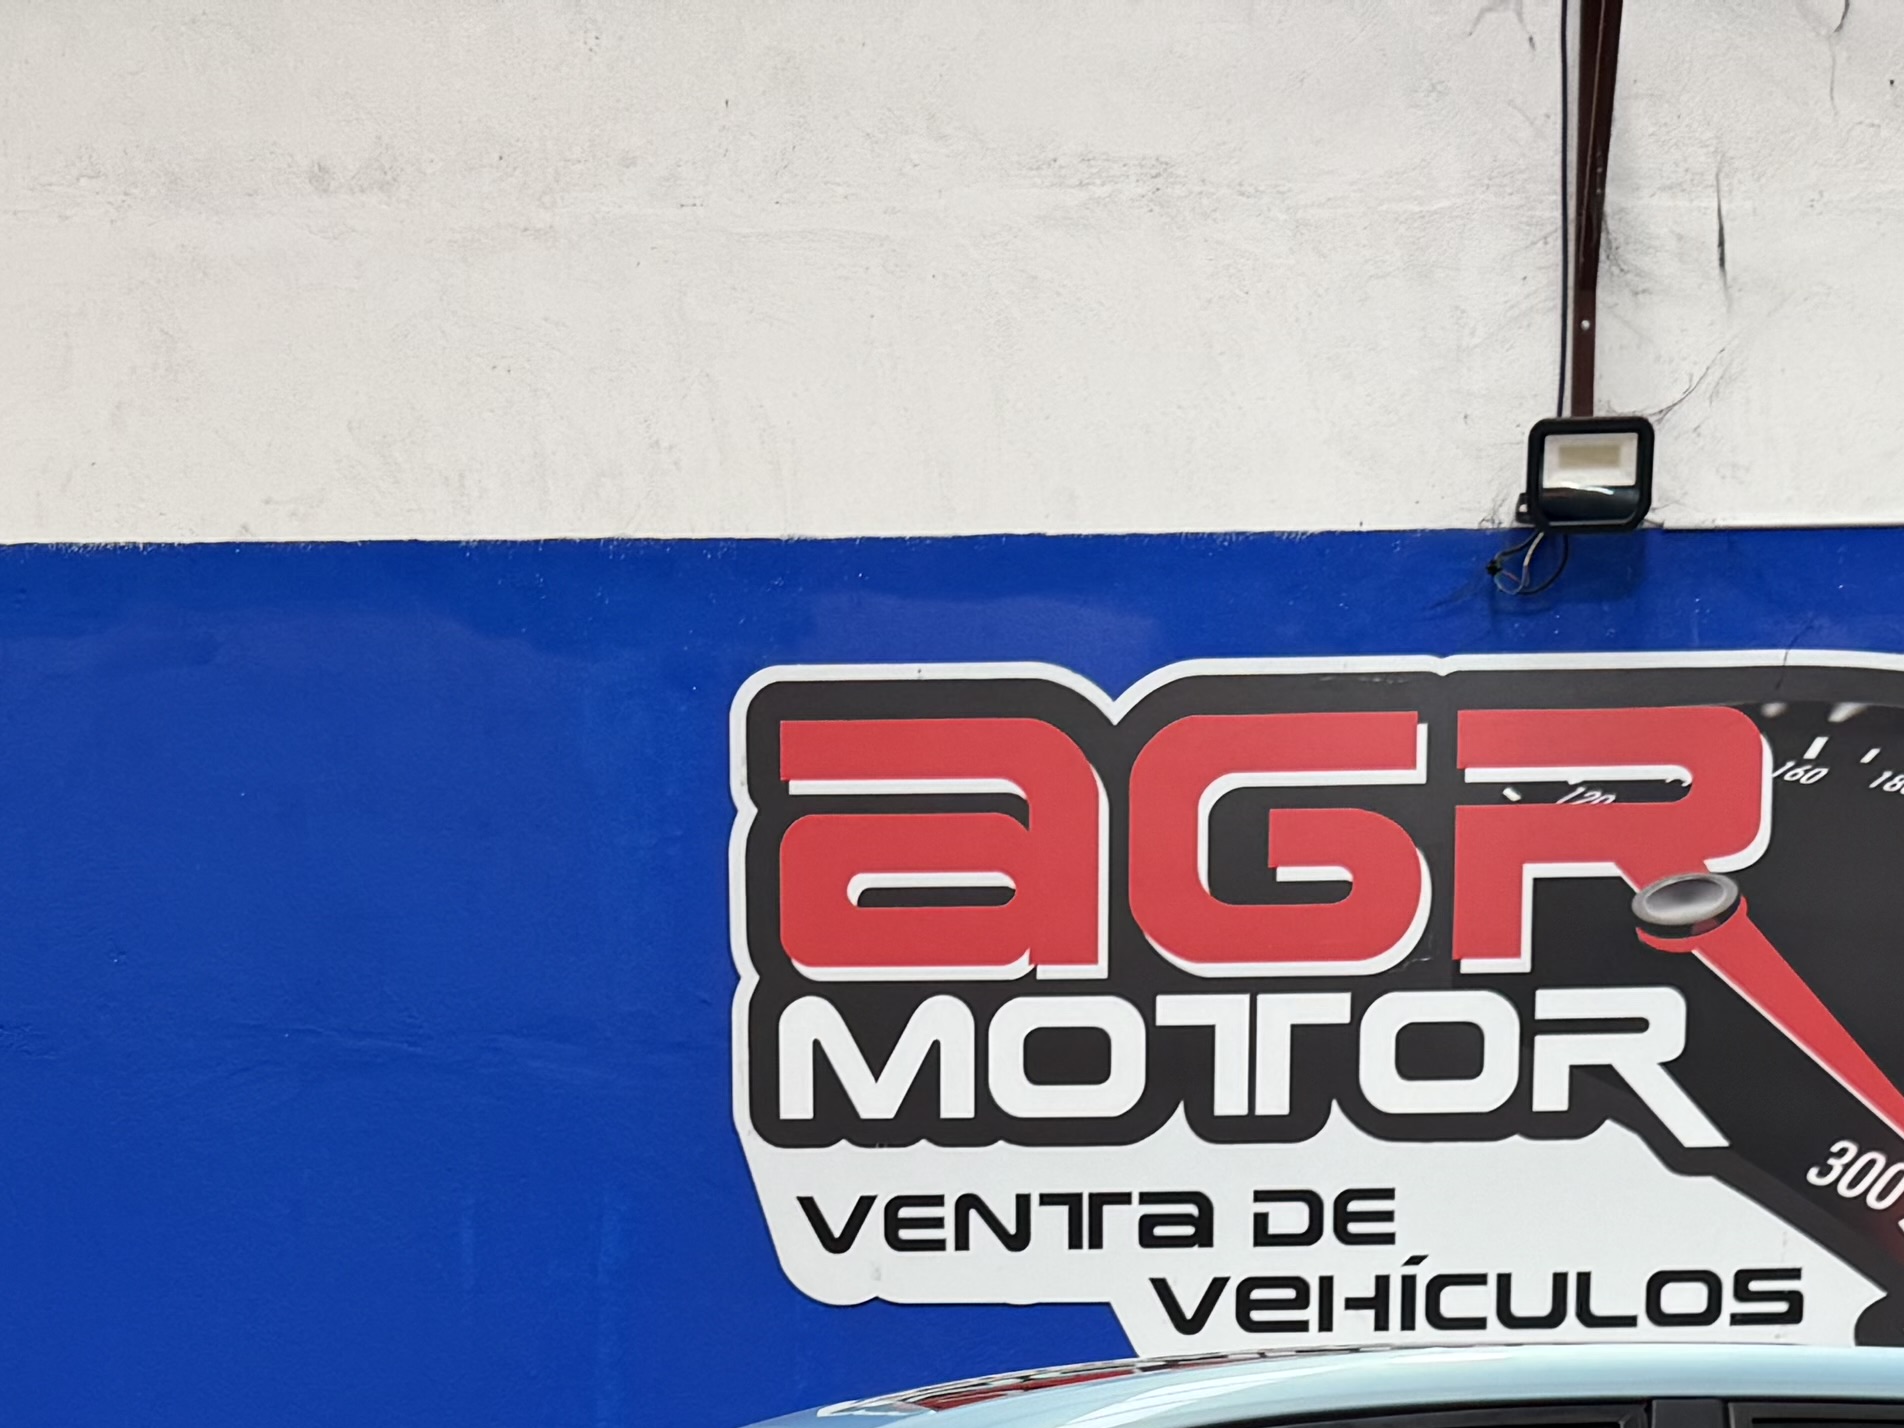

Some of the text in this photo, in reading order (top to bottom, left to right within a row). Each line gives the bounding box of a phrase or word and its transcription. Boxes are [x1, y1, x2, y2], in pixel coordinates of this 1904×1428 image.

[1772, 760, 1830, 785] 160
[778, 986, 1730, 1148] MOTOR
[1252, 1186, 1397, 1247] DE
